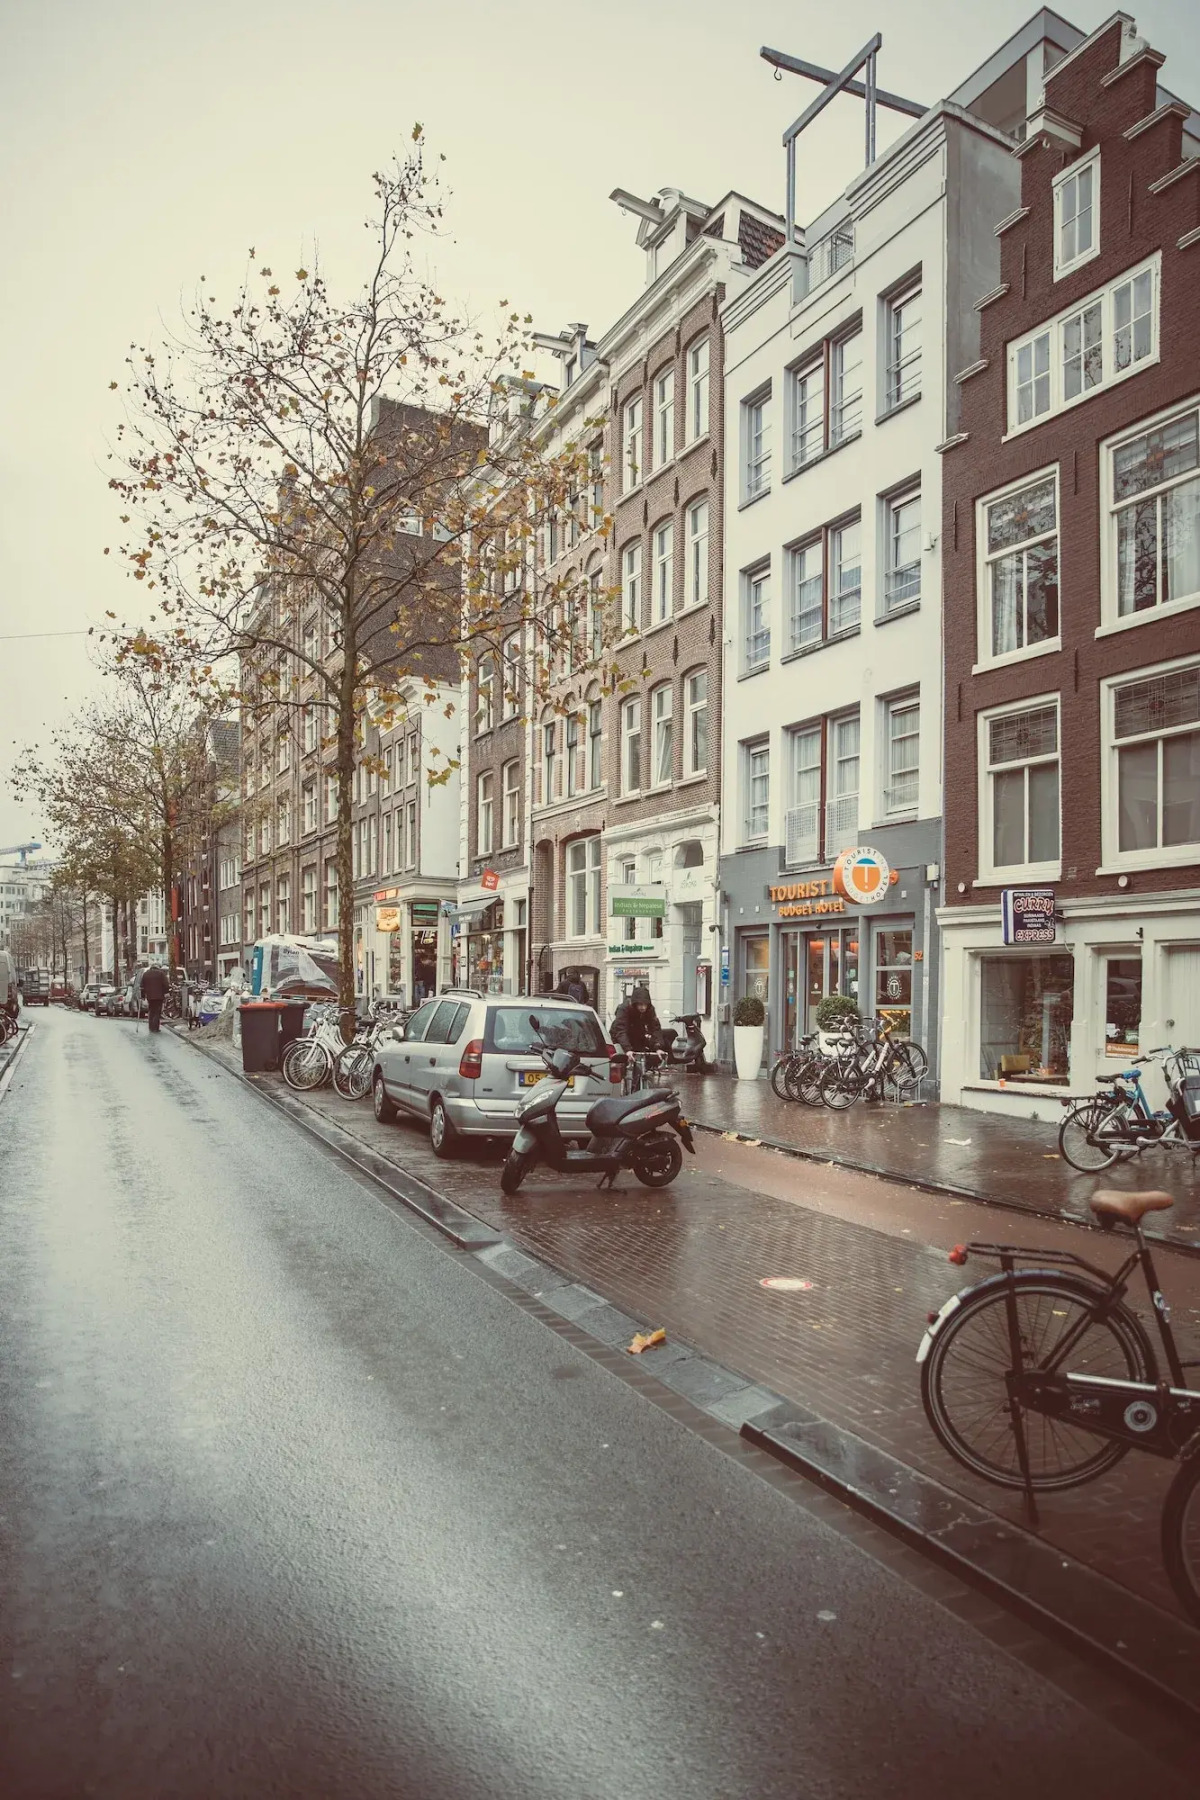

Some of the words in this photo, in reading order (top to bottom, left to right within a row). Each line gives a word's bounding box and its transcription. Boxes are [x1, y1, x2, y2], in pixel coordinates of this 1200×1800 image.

[844, 849, 877, 871] TOURIST
[770, 880, 828, 902] TOURIST
[871, 875, 888, 901] HOTEL
[639, 902, 663, 910] Nepalese
[778, 905, 813, 917] BUDGET
[815, 901, 845, 914] HOTEL
[1014, 896, 1054, 916] CURRY
[1016, 929, 1054, 941] EXPRESS
